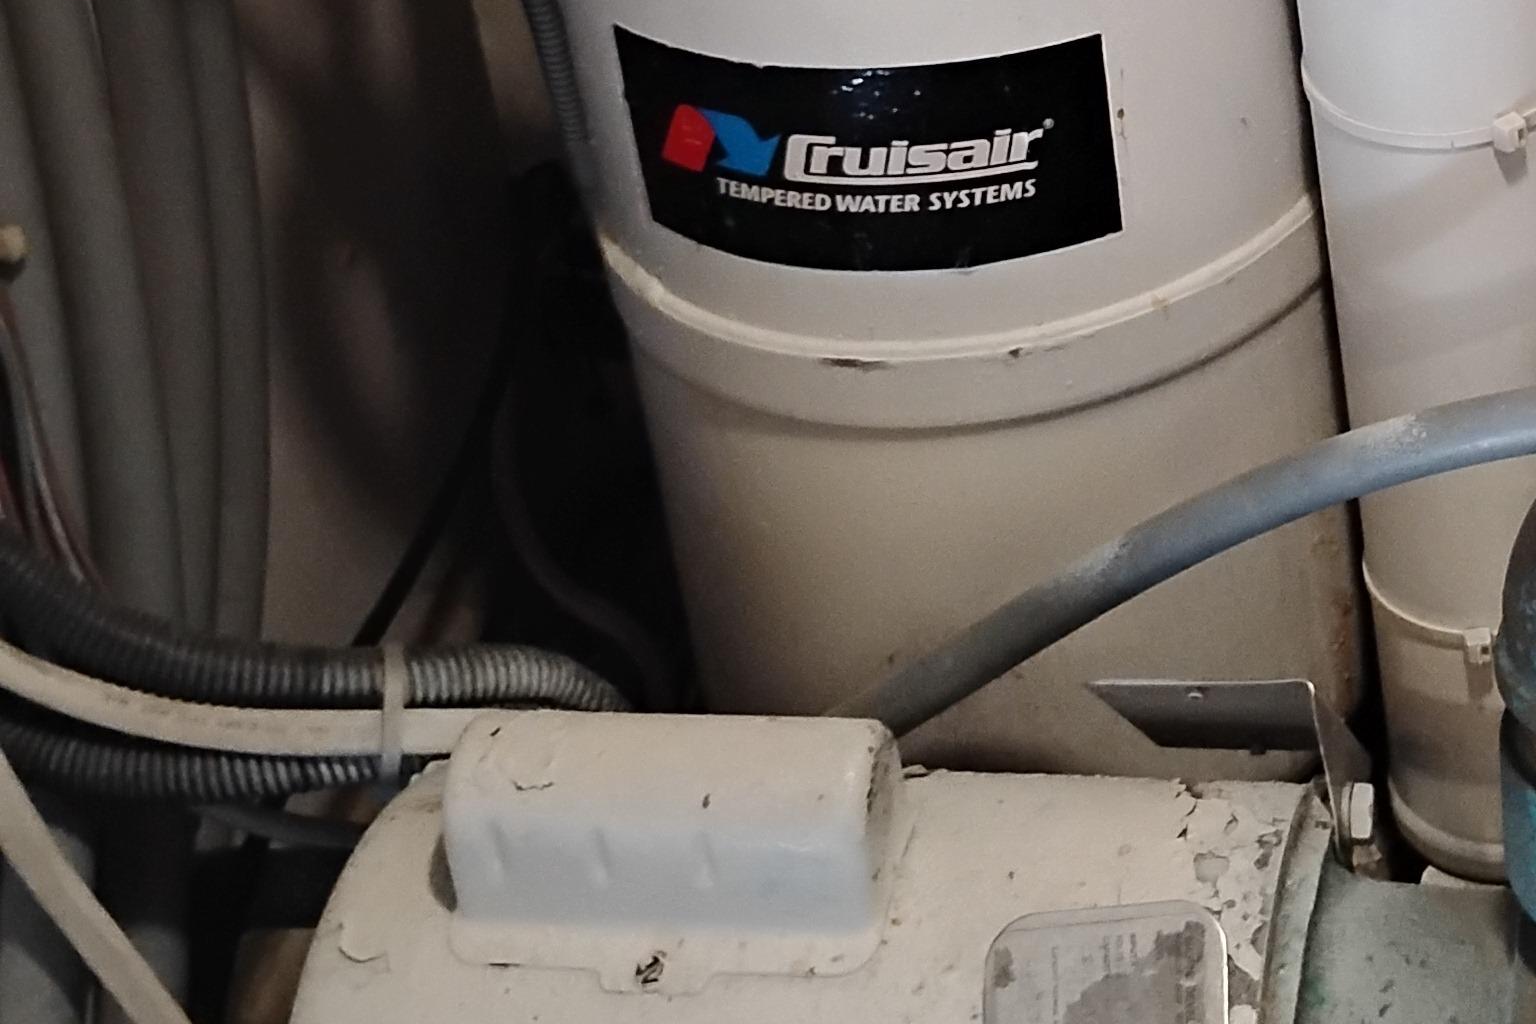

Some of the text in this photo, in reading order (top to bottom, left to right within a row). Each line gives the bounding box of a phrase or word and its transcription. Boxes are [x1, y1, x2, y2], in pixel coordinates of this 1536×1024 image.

[783, 127, 1045, 186] Cruisair
[715, 177, 1037, 214] TEMPERED WATER SYSTEMS
